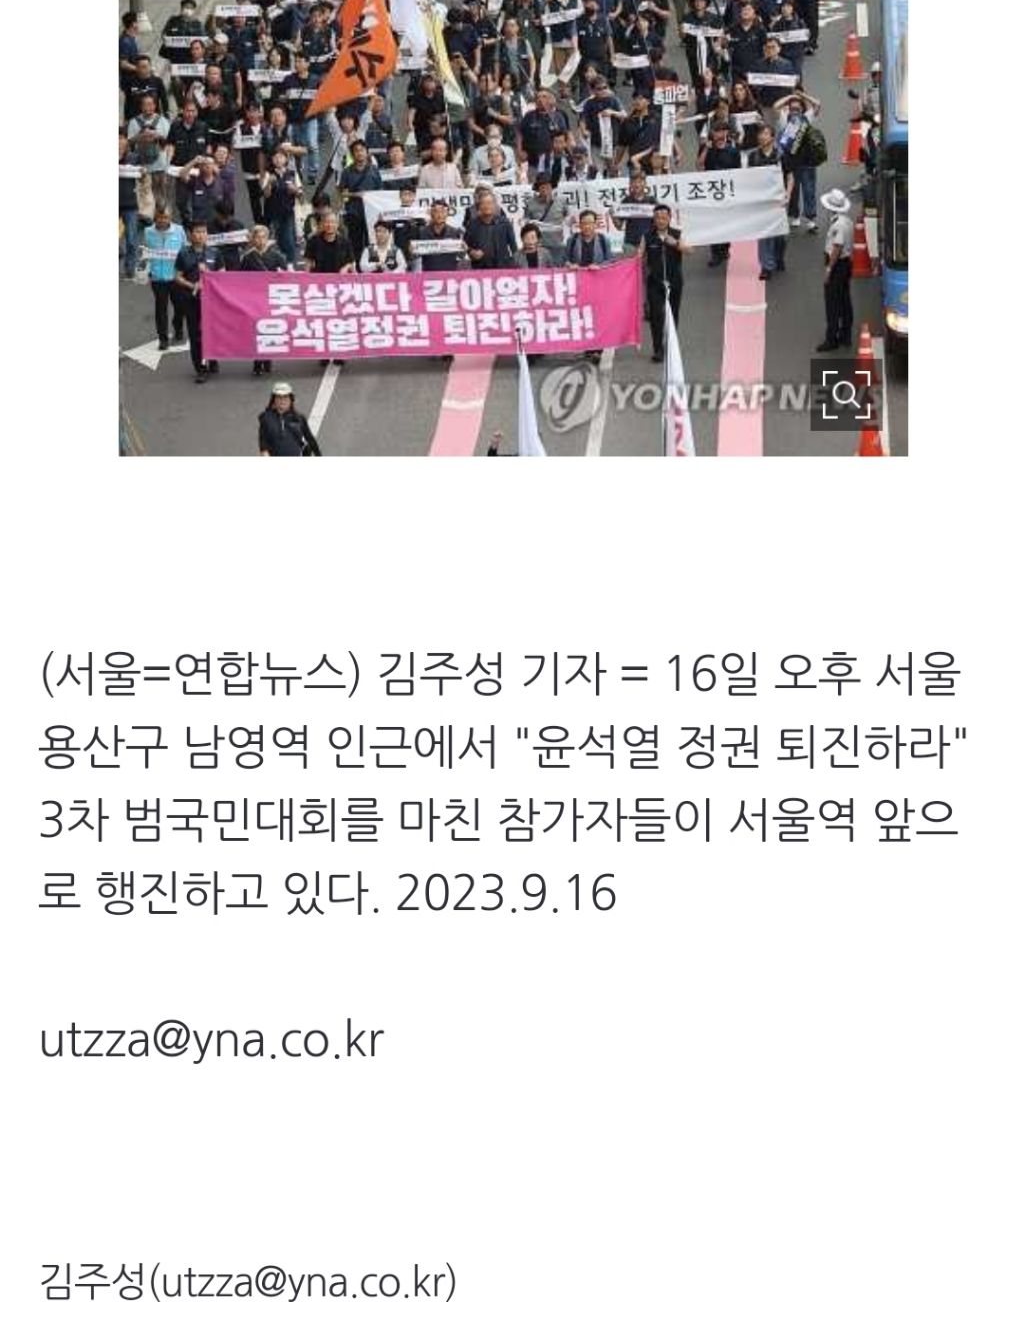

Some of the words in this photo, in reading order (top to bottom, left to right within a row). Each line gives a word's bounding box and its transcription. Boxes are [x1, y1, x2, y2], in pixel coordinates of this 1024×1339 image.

[688, 179, 735, 202] 조장!
[267, 282, 411, 316] 못살겠다
[423, 273, 578, 314] 갈아엎자!
[256, 314, 430, 354] 윤석열정권
[443, 305, 596, 346] 퇴진하라!
[43, 651, 359, 698] (서울=연합뉴스)
[379, 652, 502, 696] 김주성
[523, 652, 607, 696] 기자
[668, 652, 757, 696] 16일
[775, 652, 861, 696] 오후
[876, 652, 961, 696] 서울
[38, 725, 168, 769] 용산구
[186, 725, 307, 769] 남영역
[329, 725, 498, 769] 인근에서
[516, 725, 660, 769] "윤석열
[679, 725, 759, 769] 정권
[777, 725, 967, 769] 퇴진하라"
[40, 798, 109, 842] 3차
[126, 798, 384, 843] 범국민대회를
[400, 798, 480, 842] 마친
[499, 798, 710, 842] 참가자들이
[730, 798, 856, 842] 서울역
[875, 798, 958, 842] 앞으
[39, 873, 81, 908] 로
[96, 871, 268, 915] 행진하고
[285, 871, 379, 915] 있다.
[397, 873, 616, 913] 2023.9.16
[41, 1018, 384, 1064] utzza@yna.co.kr
[41, 1262, 456, 1302] 김주성(utzza@yna.co.kr)
